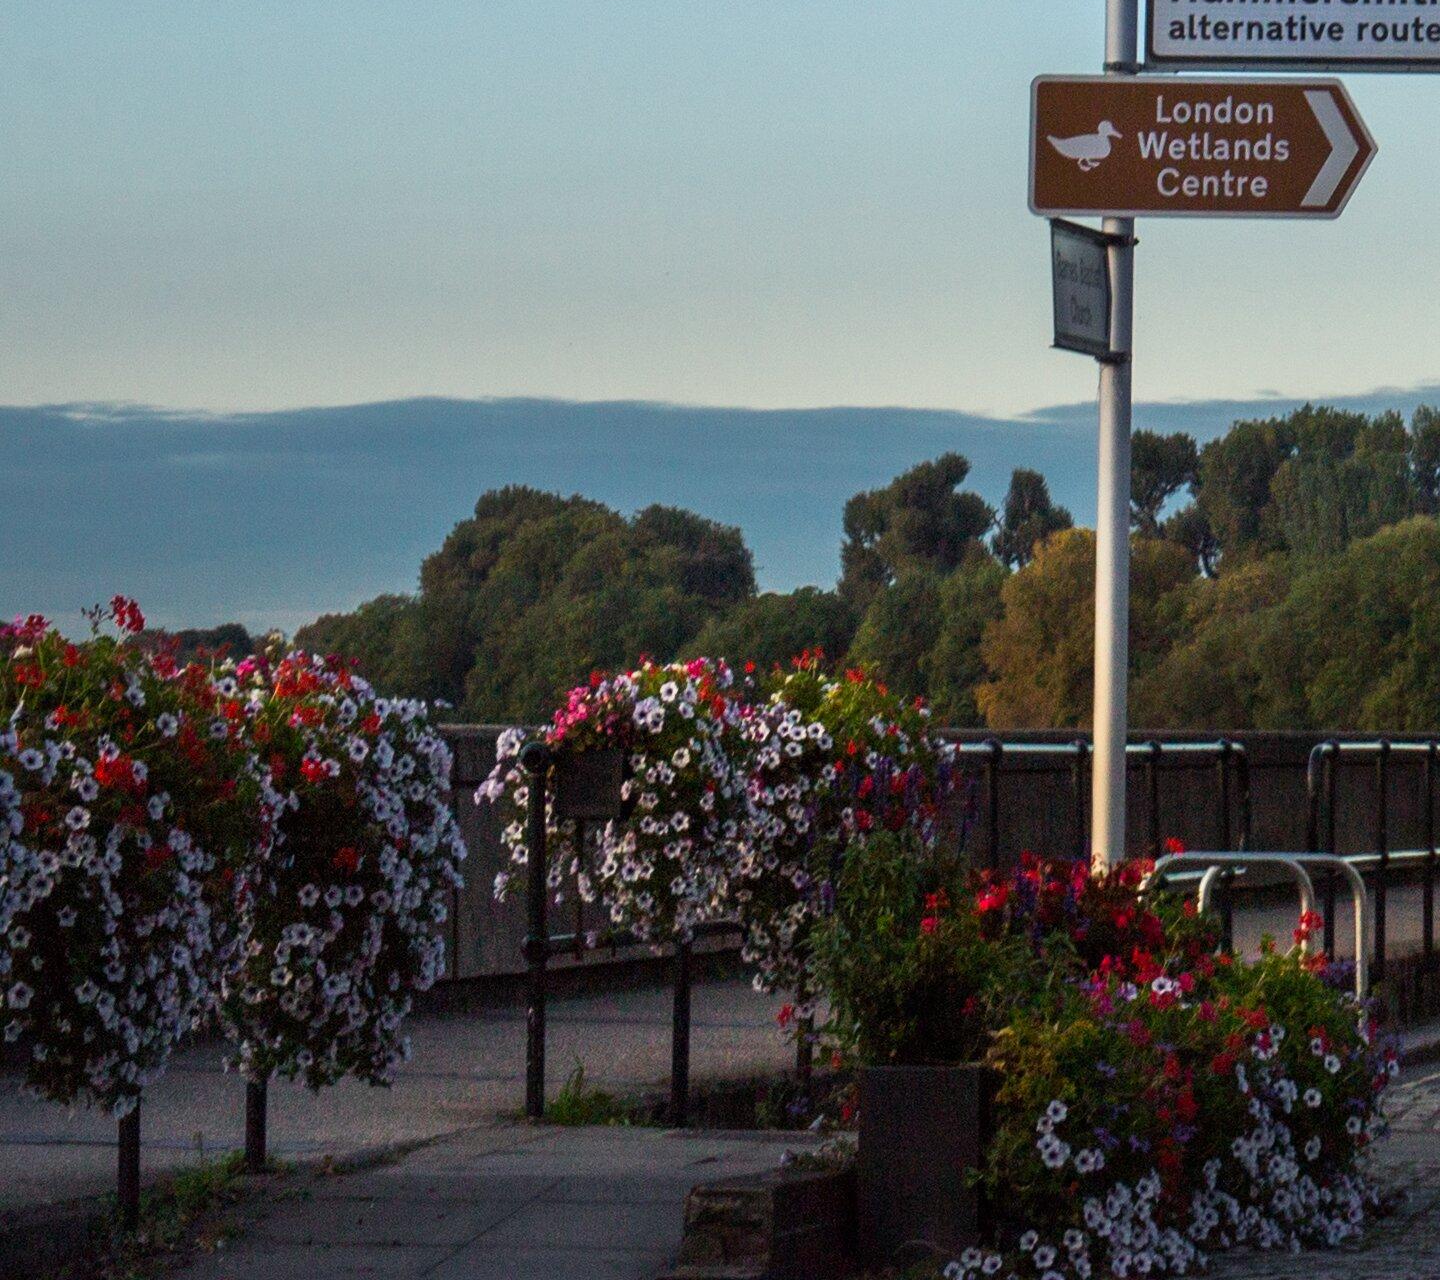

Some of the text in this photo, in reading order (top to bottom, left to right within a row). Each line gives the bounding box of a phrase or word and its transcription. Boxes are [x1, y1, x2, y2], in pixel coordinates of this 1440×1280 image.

[1168, 15, 1344, 42] alternative
[1156, 95, 1274, 124] London
[1137, 131, 1290, 161] Wetlands
[1156, 167, 1268, 197] Centre
